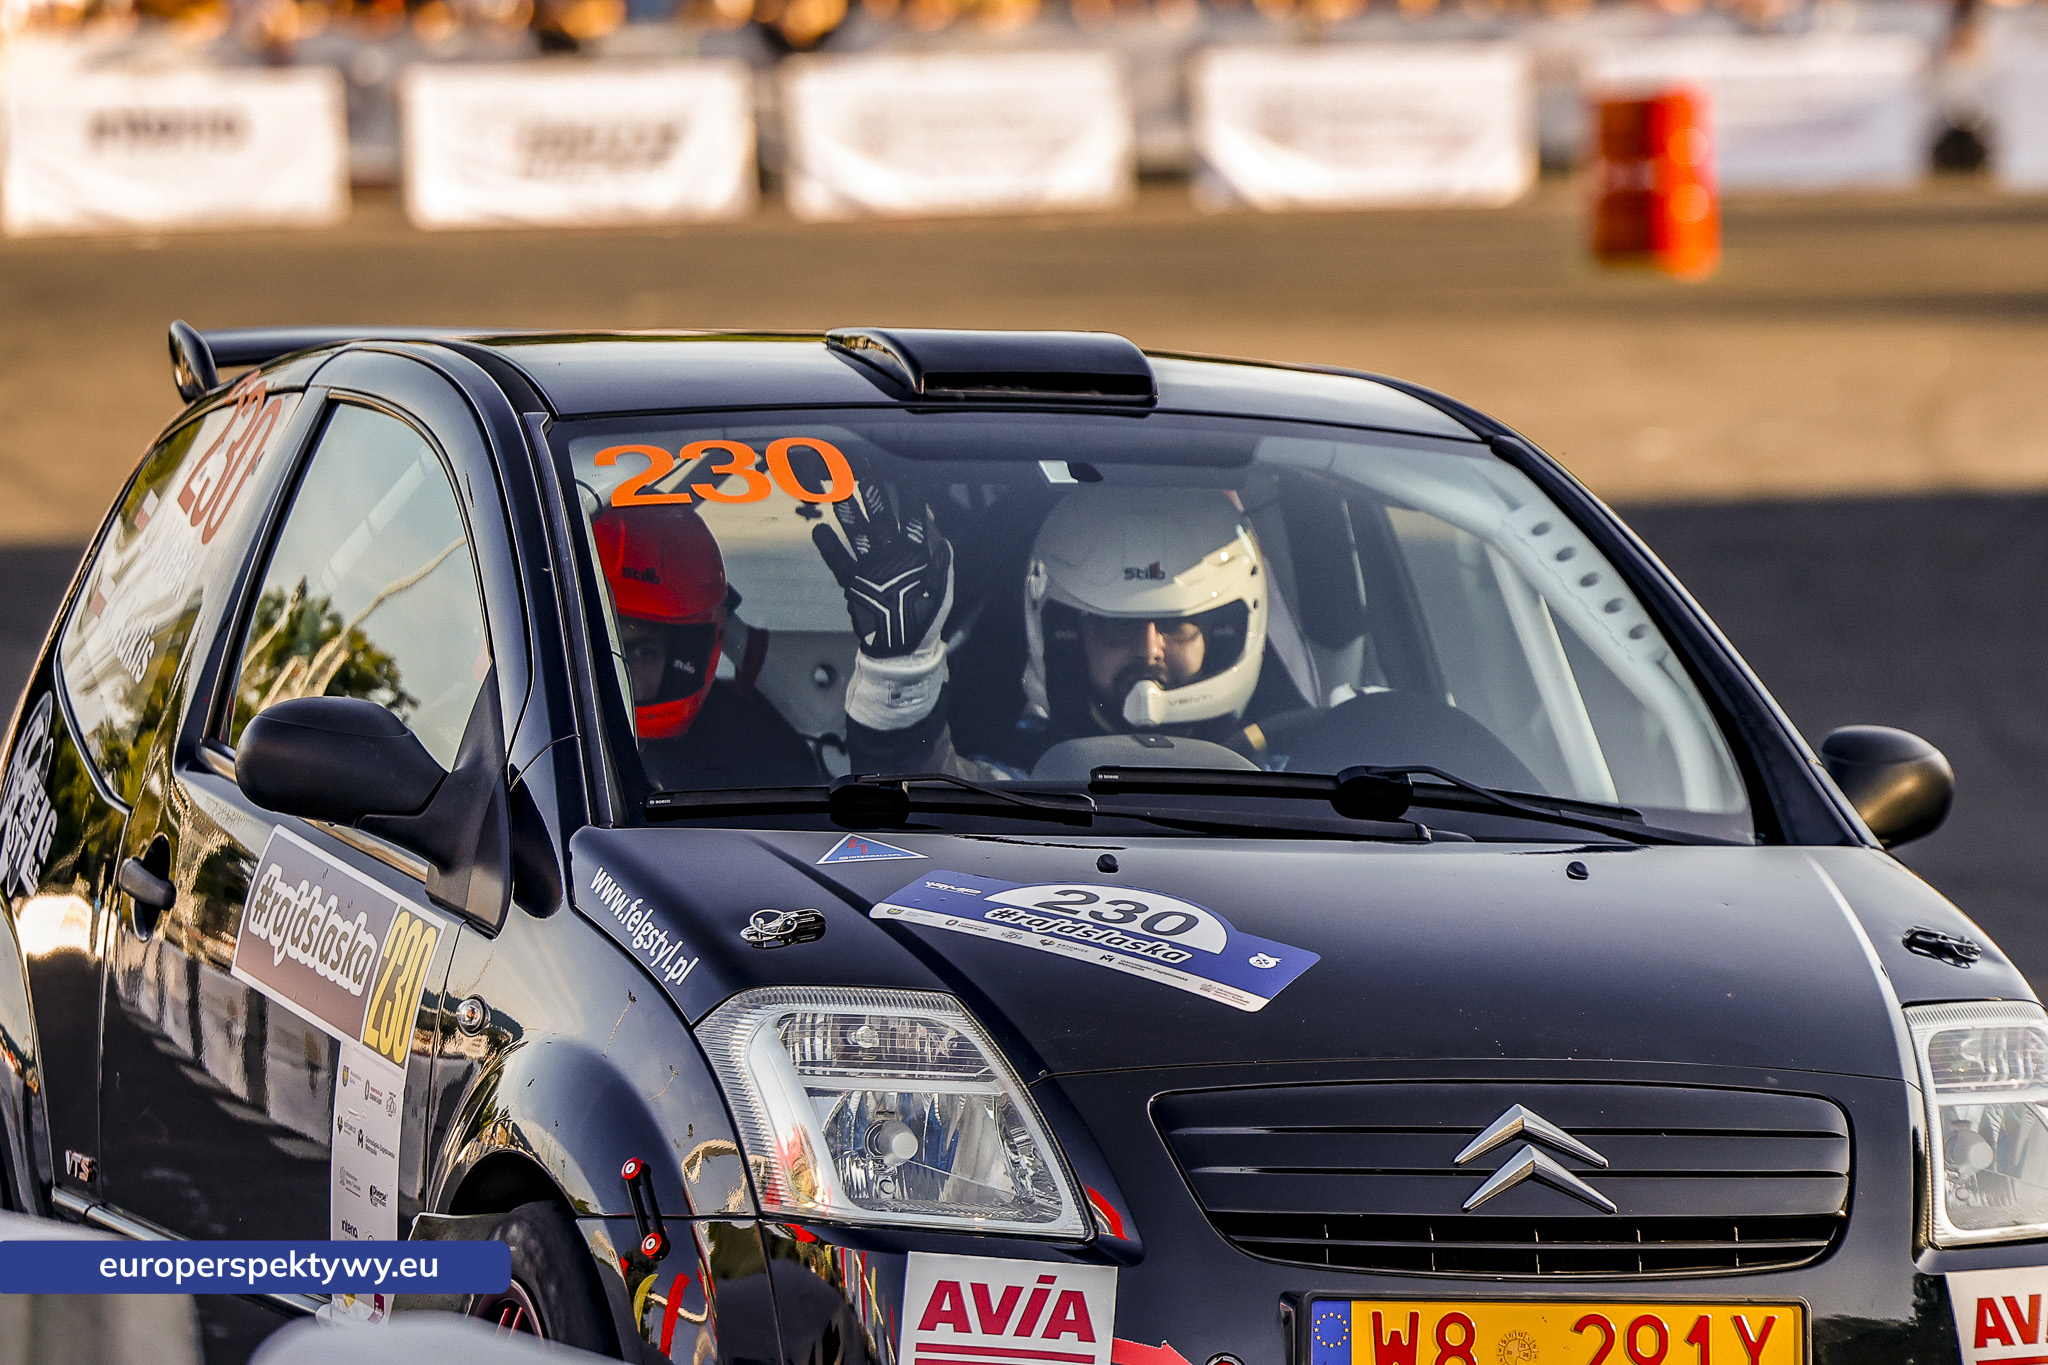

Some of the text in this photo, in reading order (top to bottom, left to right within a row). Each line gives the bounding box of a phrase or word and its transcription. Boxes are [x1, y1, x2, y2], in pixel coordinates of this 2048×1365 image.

[177, 369, 282, 544] 230
[594, 437, 854, 507] 230
[1124, 561, 1165, 580] Stilo
[251, 871, 374, 987] #rajdslaska
[590, 866, 699, 985] www.felgstyl.pl
[990, 908, 1188, 961] #rajdslaska
[1033, 889, 1199, 936] 230
[363, 911, 437, 1063] 230
[65, 1150, 90, 1182] VTS
[1371, 1311, 1477, 1365] W8
